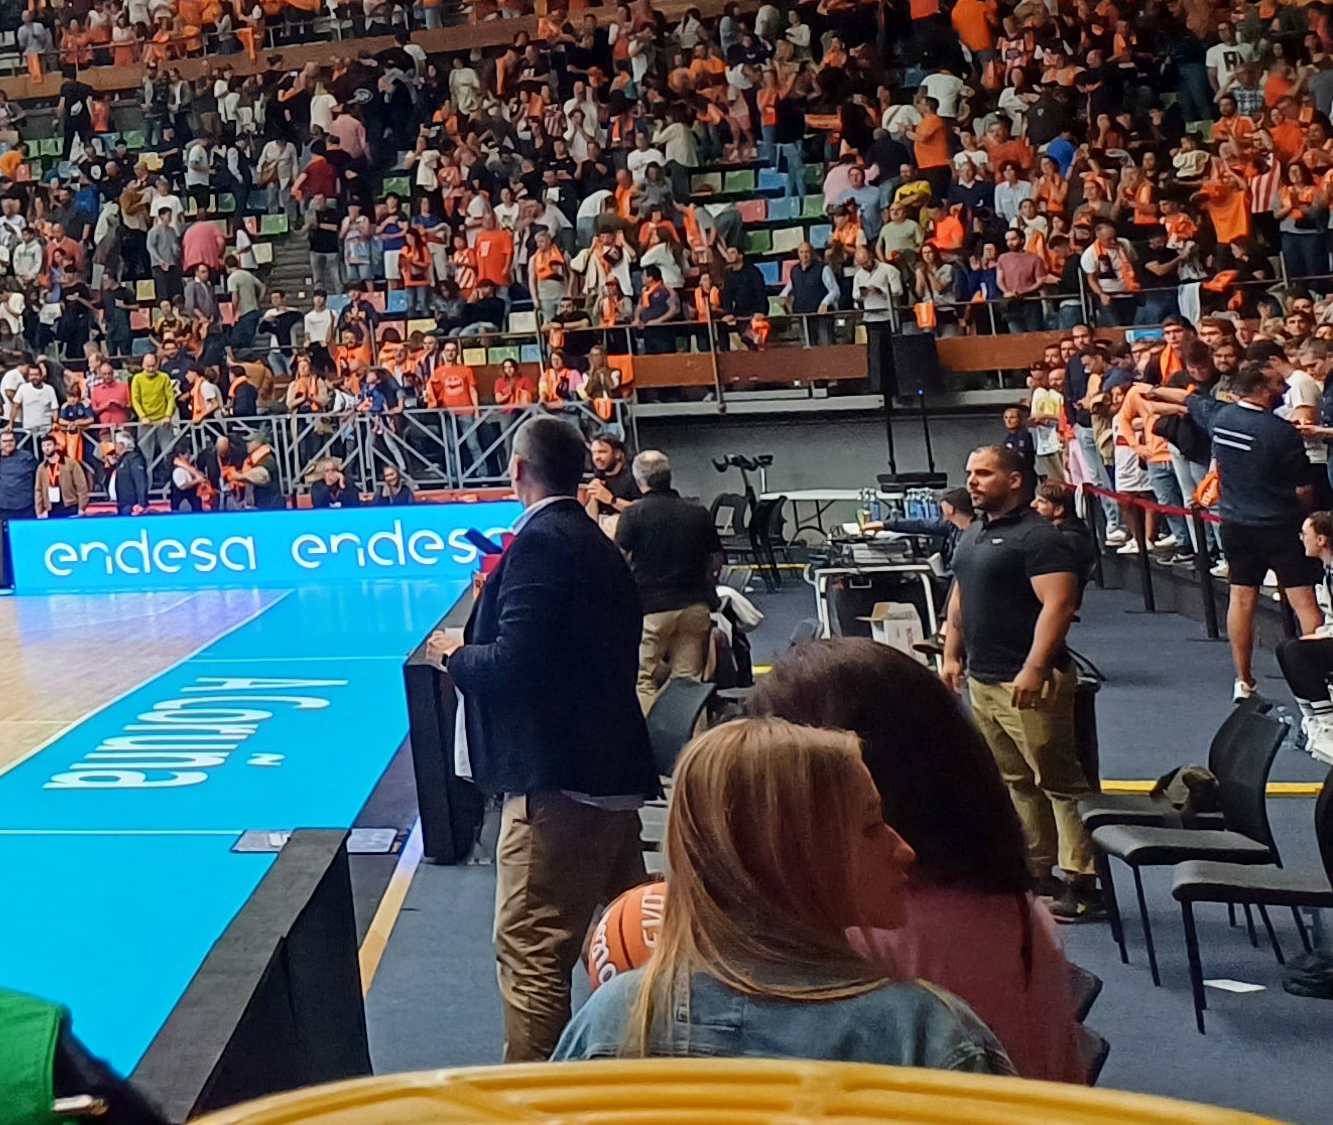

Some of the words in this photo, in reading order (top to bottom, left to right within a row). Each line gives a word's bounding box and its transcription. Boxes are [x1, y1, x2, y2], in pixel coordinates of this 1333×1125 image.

[44, 528, 256, 577] endesa
[292, 519, 479, 569] endes
[42, 695, 331, 790] Coruña
